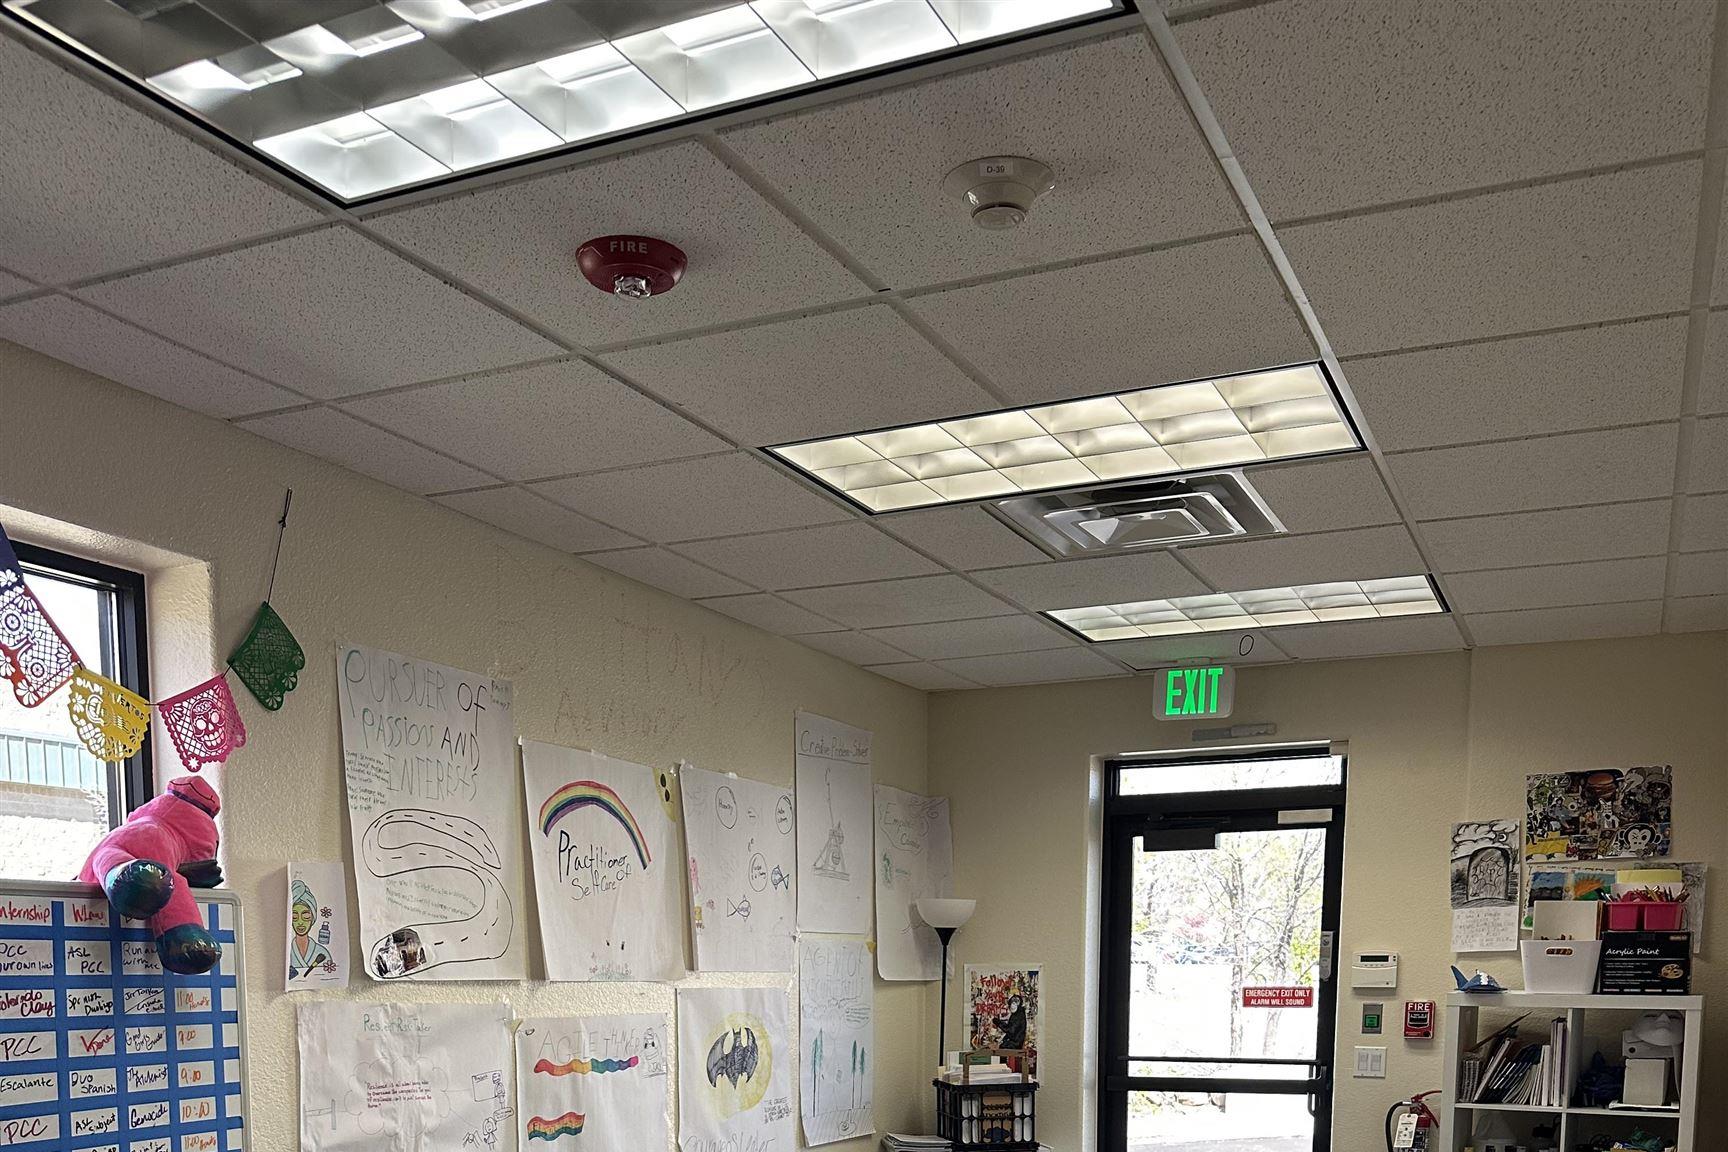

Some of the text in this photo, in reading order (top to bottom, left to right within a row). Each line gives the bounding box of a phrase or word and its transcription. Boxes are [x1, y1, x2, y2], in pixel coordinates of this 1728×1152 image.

[610, 240, 648, 254] FIRE
[344, 650, 447, 718] PURSUER
[1165, 667, 1224, 716] EXIT
[440, 726, 480, 772] AND
[558, 829, 628, 883] Practitioner
[571, 870, 617, 901] Self Care
[68, 946, 91, 960] ASL
[1605, 947, 1660, 956] Acrylic Paint
[81, 960, 105, 974] PCC
[123, 958, 149, 967] with
[1245, 989, 1311, 997] EMERGENCY EXIT ONLY
[21, 1001, 55, 1017] Clay
[1250, 998, 1305, 1006] ALARM WILL SOUND
[0, 1035, 42, 1061] PCC
[0, 1077, 54, 1093] Escalante
[4, 1118, 48, 1144] PCC
[75, 1117, 93, 1134] ASL
